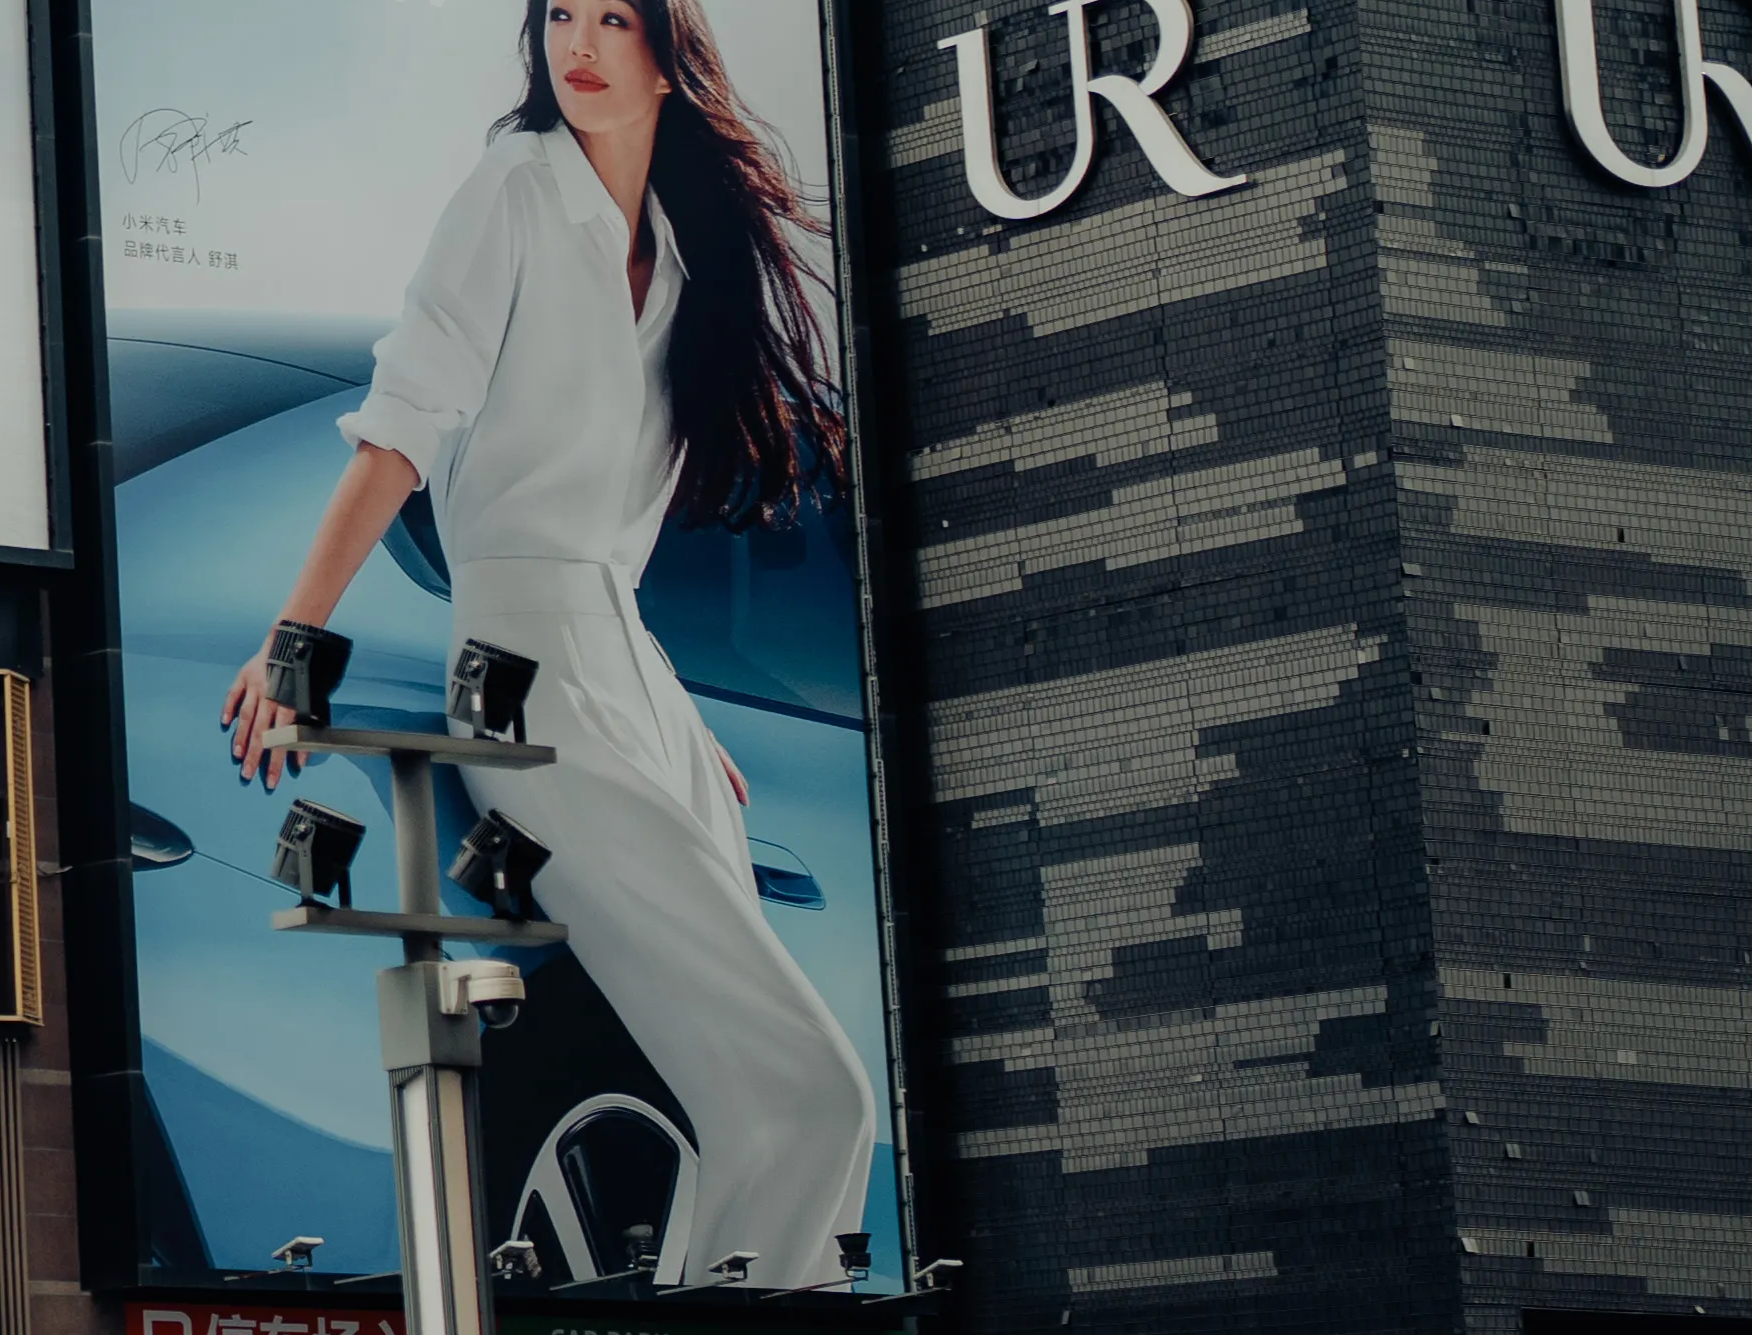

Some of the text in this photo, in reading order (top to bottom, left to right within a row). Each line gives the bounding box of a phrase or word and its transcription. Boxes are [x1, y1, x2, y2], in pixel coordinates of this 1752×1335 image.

[122, 213, 188, 236] 小米汽车
[123, 240, 239, 271] 品牌代言人 舒淇
